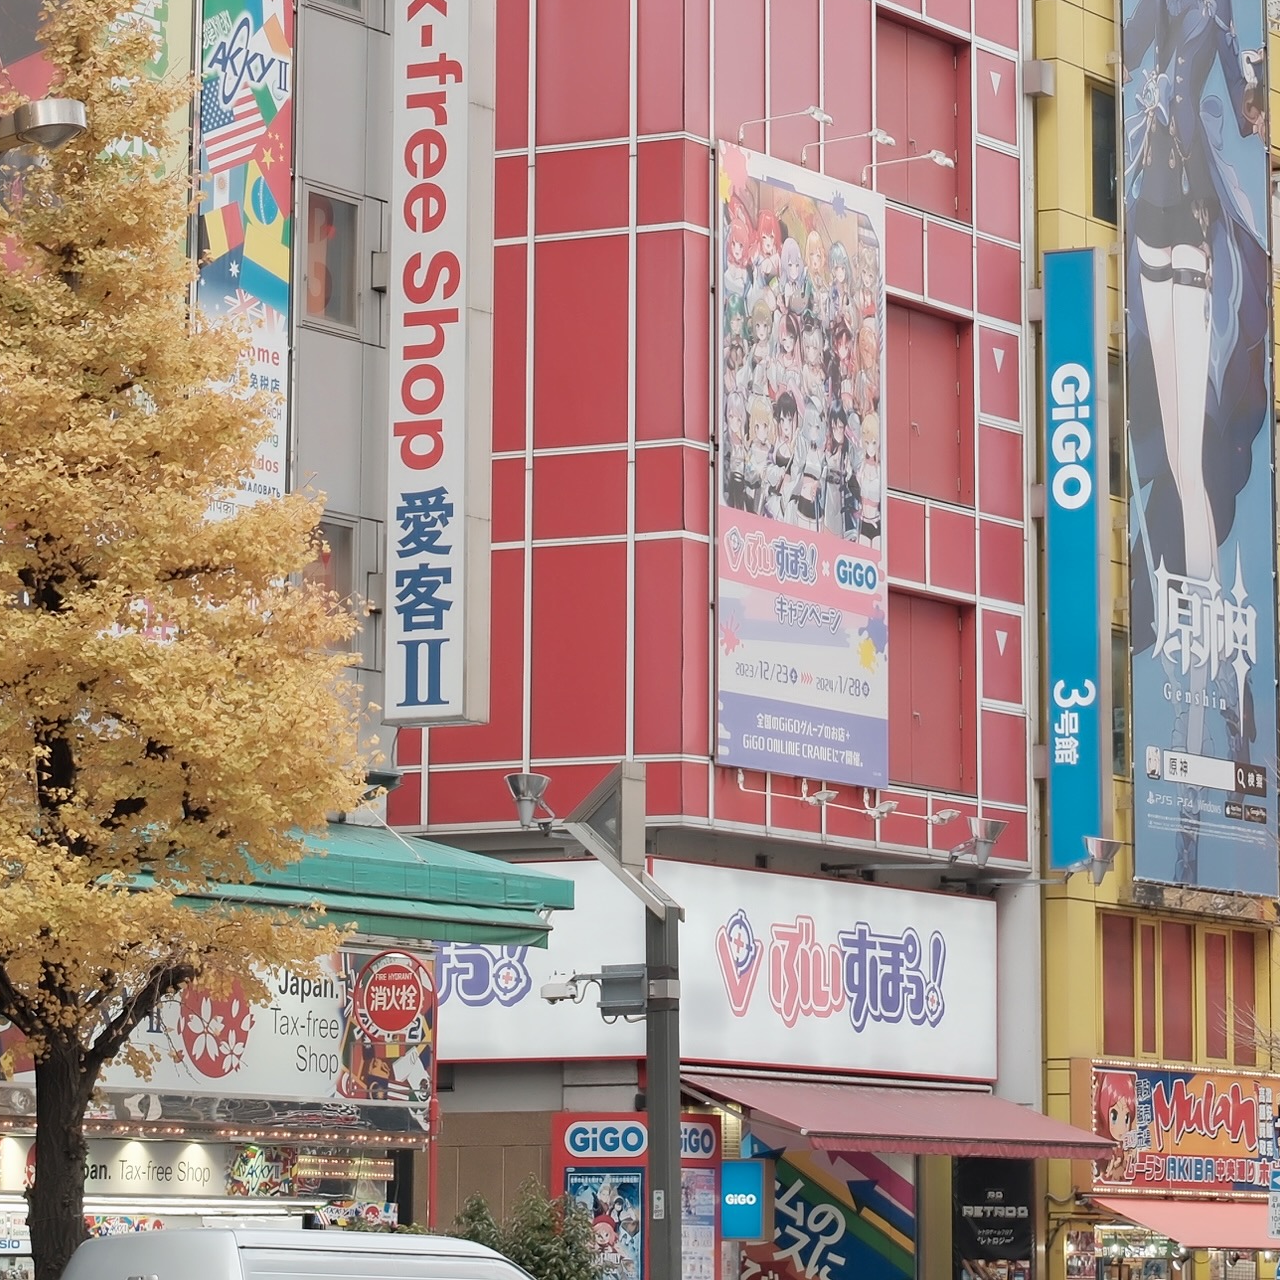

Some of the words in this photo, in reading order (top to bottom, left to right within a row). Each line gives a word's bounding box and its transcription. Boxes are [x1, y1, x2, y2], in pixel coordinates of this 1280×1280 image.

[208, 16, 276, 106] AKKY
[393, 250, 461, 471] Shop
[1051, 362, 1092, 510] GiGO
[836, 559, 877, 590] GiGO
[775, 595, 842, 634] キャンペーン
[1163, 683, 1228, 711] Genshin
[1053, 678, 1097, 766] 3号館
[743, 734, 765, 751] GiGO
[767, 738, 801, 756] ONLINE
[1155, 793, 1173, 806] PS5
[1176, 796, 1193, 808] PS4
[278, 971, 339, 1002] Japan.
[388, 972, 413, 980] HYDRANT
[370, 984, 418, 1011] 消火栓
[270, 1008, 339, 1039] Tax-free
[295, 1046, 339, 1077] Shop
[1152, 1078, 1258, 1152] Mulan
[569, 1126, 644, 1152] GiGO
[119, 1160, 173, 1182] Tax-free
[177, 1161, 211, 1187] Shop
[725, 1193, 757, 1205] GiGO
